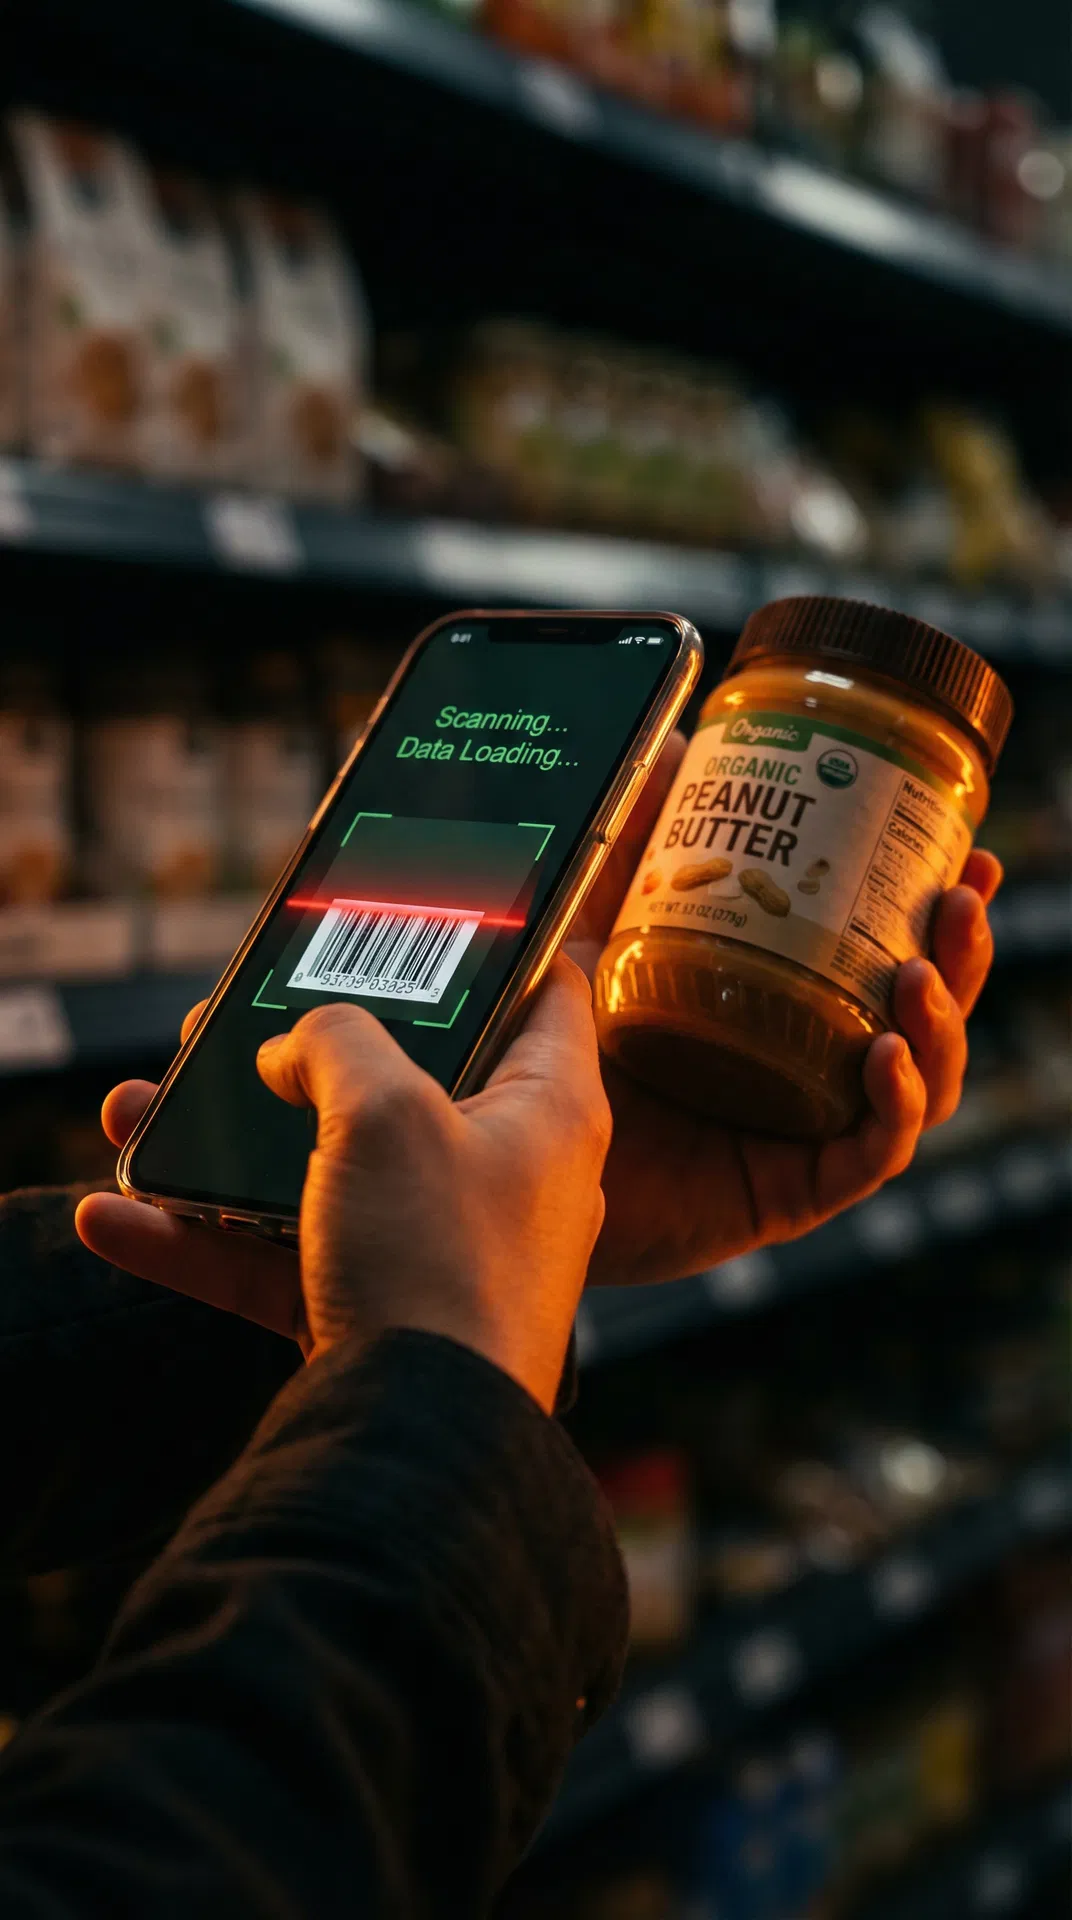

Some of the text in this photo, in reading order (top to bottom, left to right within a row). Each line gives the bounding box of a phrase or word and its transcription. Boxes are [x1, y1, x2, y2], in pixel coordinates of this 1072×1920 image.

[435, 706, 568, 736] Scanning...
[731, 718, 799, 743] Organic
[396, 736, 579, 771] Data Loading...
[704, 756, 802, 785] ORGANIC
[677, 781, 816, 828] PEANUT
[664, 817, 798, 867] BUTTER
